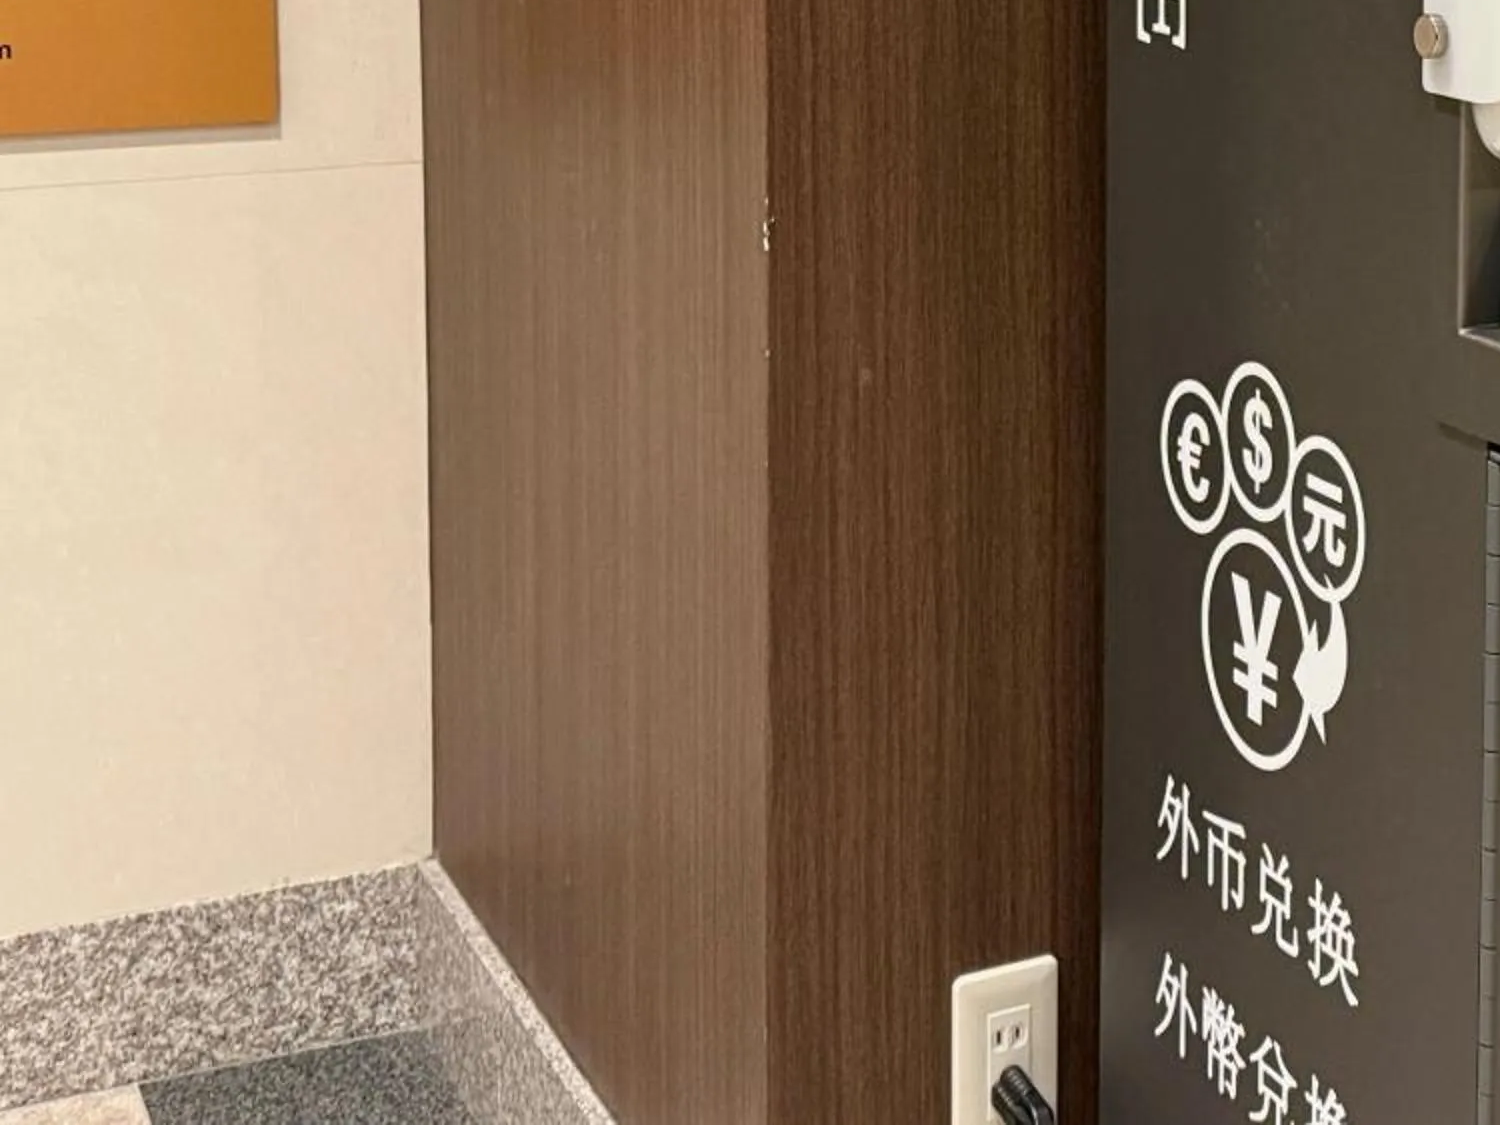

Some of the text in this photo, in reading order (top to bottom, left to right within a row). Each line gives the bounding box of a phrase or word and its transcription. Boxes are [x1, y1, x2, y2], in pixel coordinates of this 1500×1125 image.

[1302, 473, 1346, 568] 元
[1156, 774, 1358, 1007] 外币兑换
